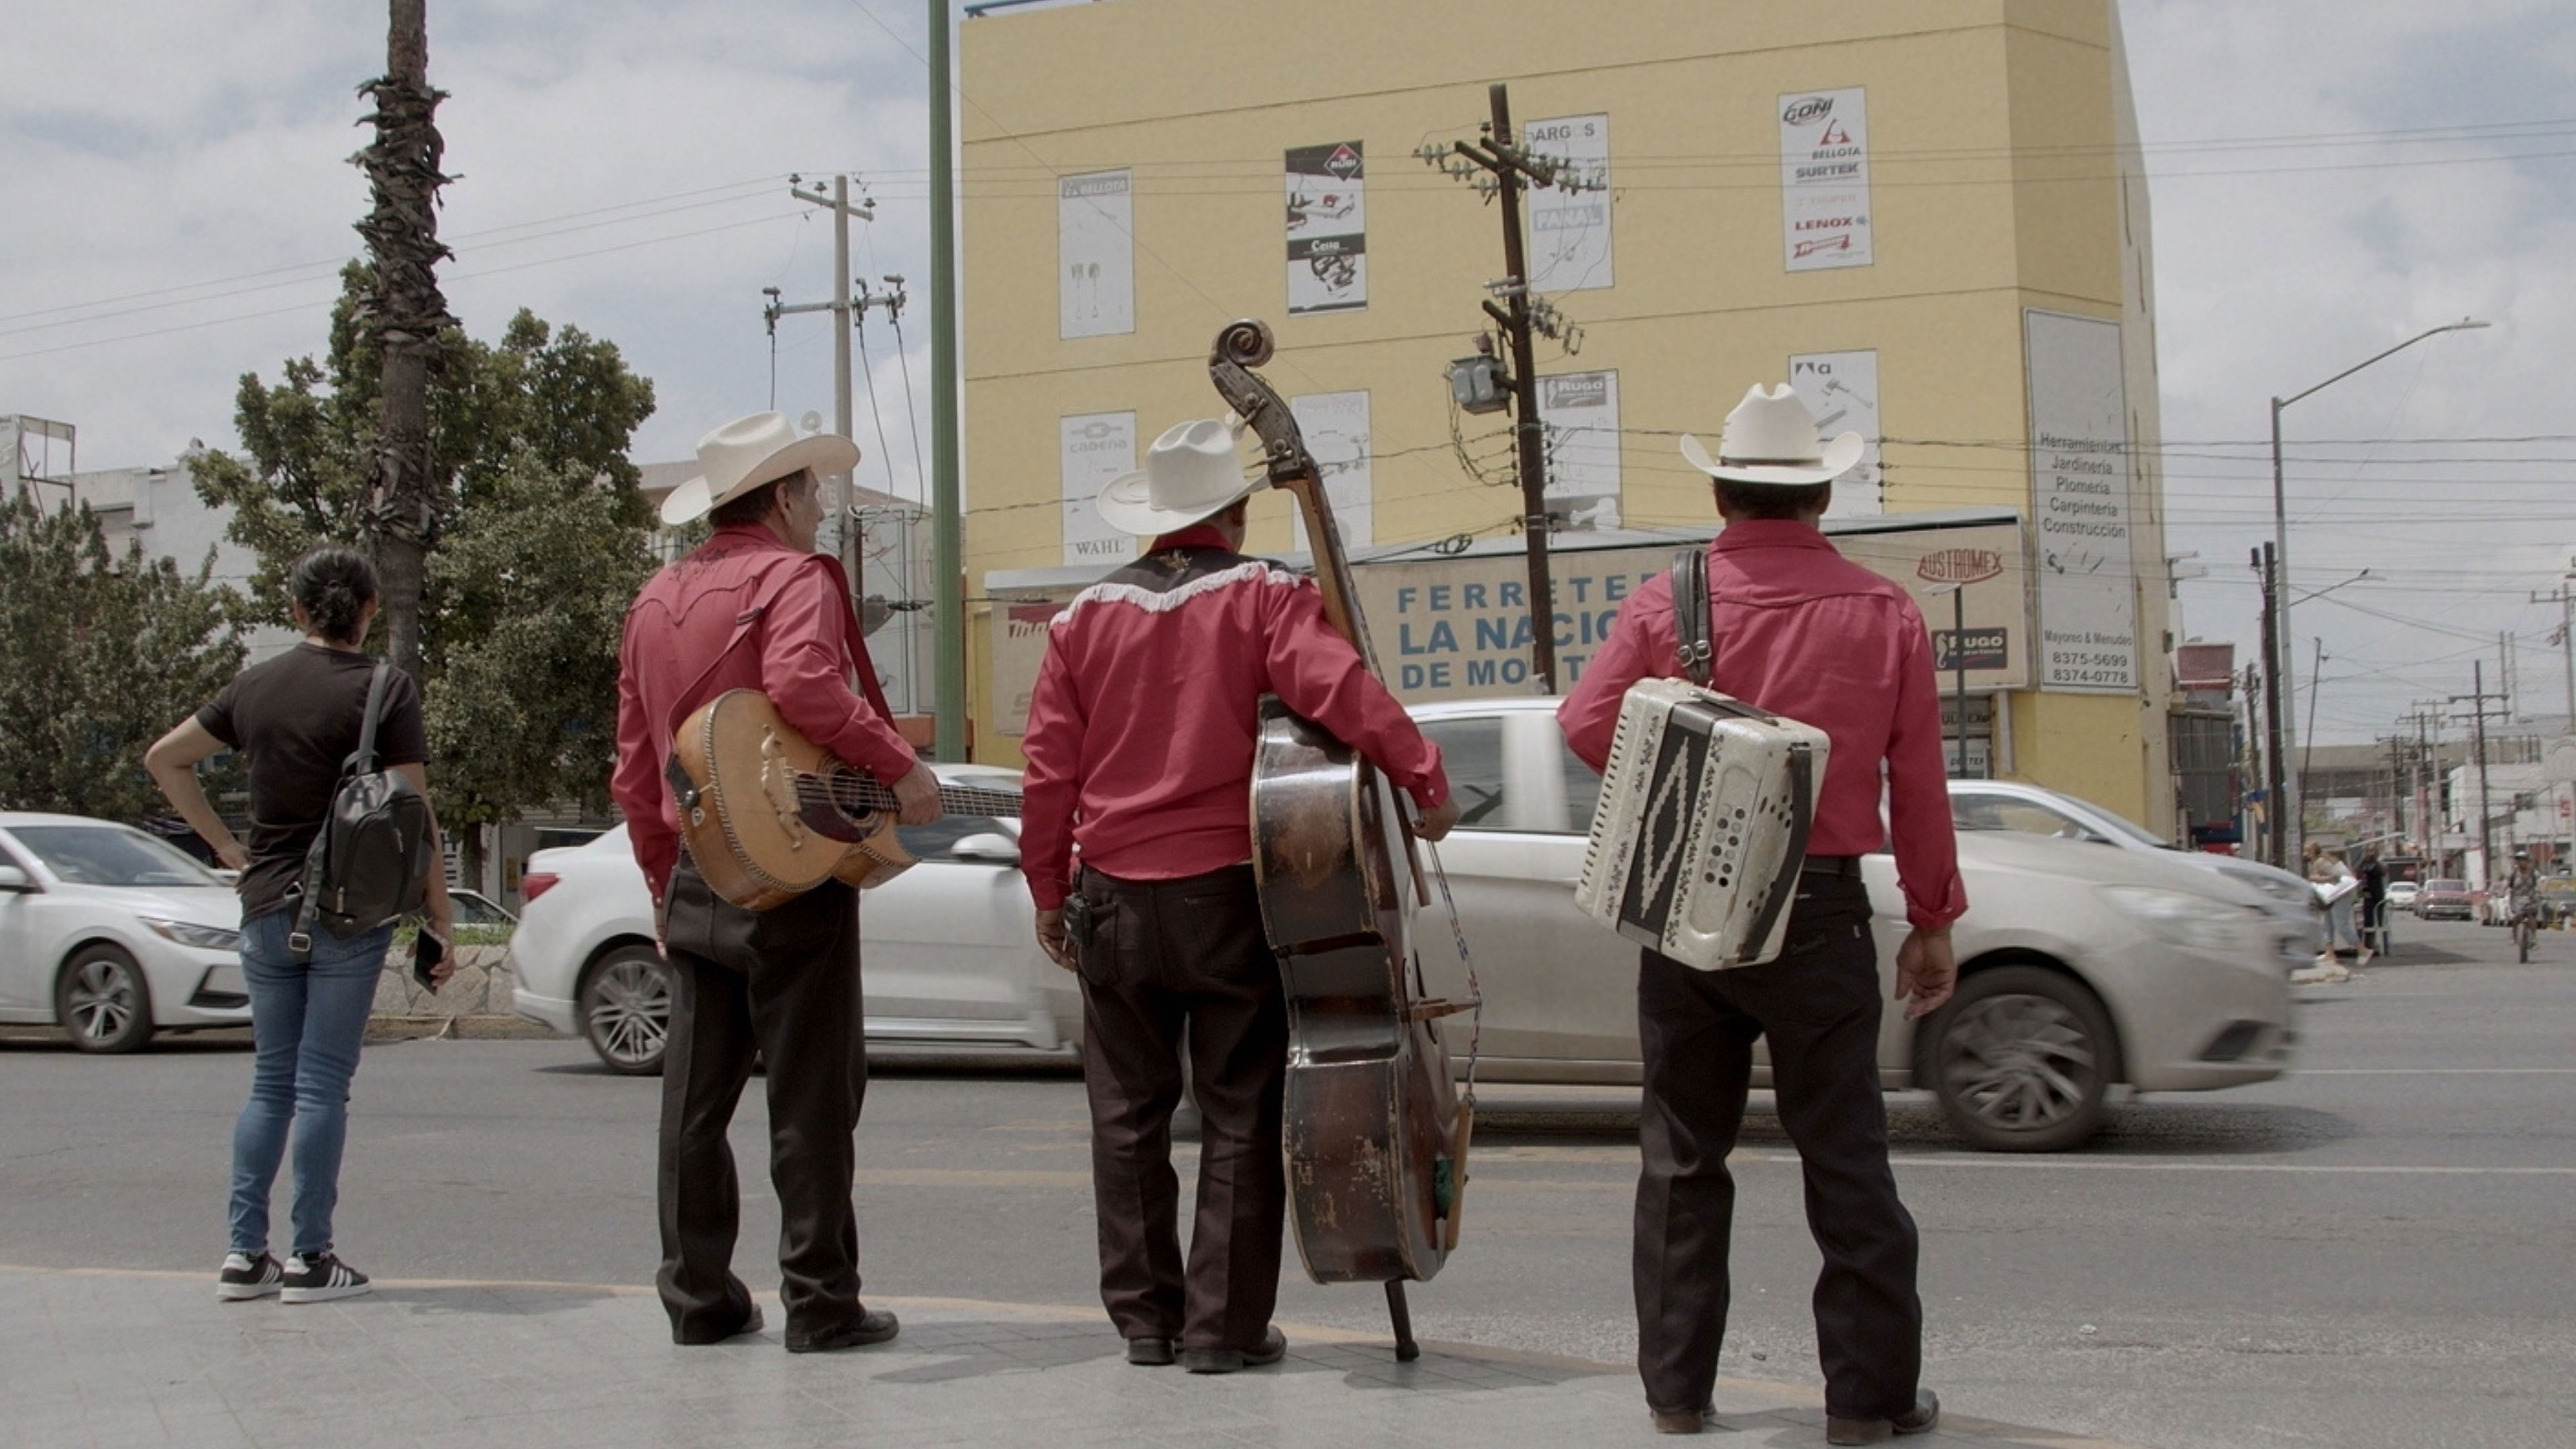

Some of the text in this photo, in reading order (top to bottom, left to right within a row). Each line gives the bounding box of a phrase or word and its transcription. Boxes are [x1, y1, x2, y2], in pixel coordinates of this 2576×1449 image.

[1812, 147, 1860, 160] BELLOTA
[1796, 162, 1860, 178] SURTEK
[1795, 216, 1852, 230] LENOX
[1076, 541, 1124, 555] WAHL
[1917, 549, 2002, 578] AUSTROMEX
[1400, 621, 1460, 655] LA
[2053, 651, 2127, 667] 8375-5699
[1402, 662, 1451, 690] DE
[2053, 669, 2129, 684] 8374-0778
